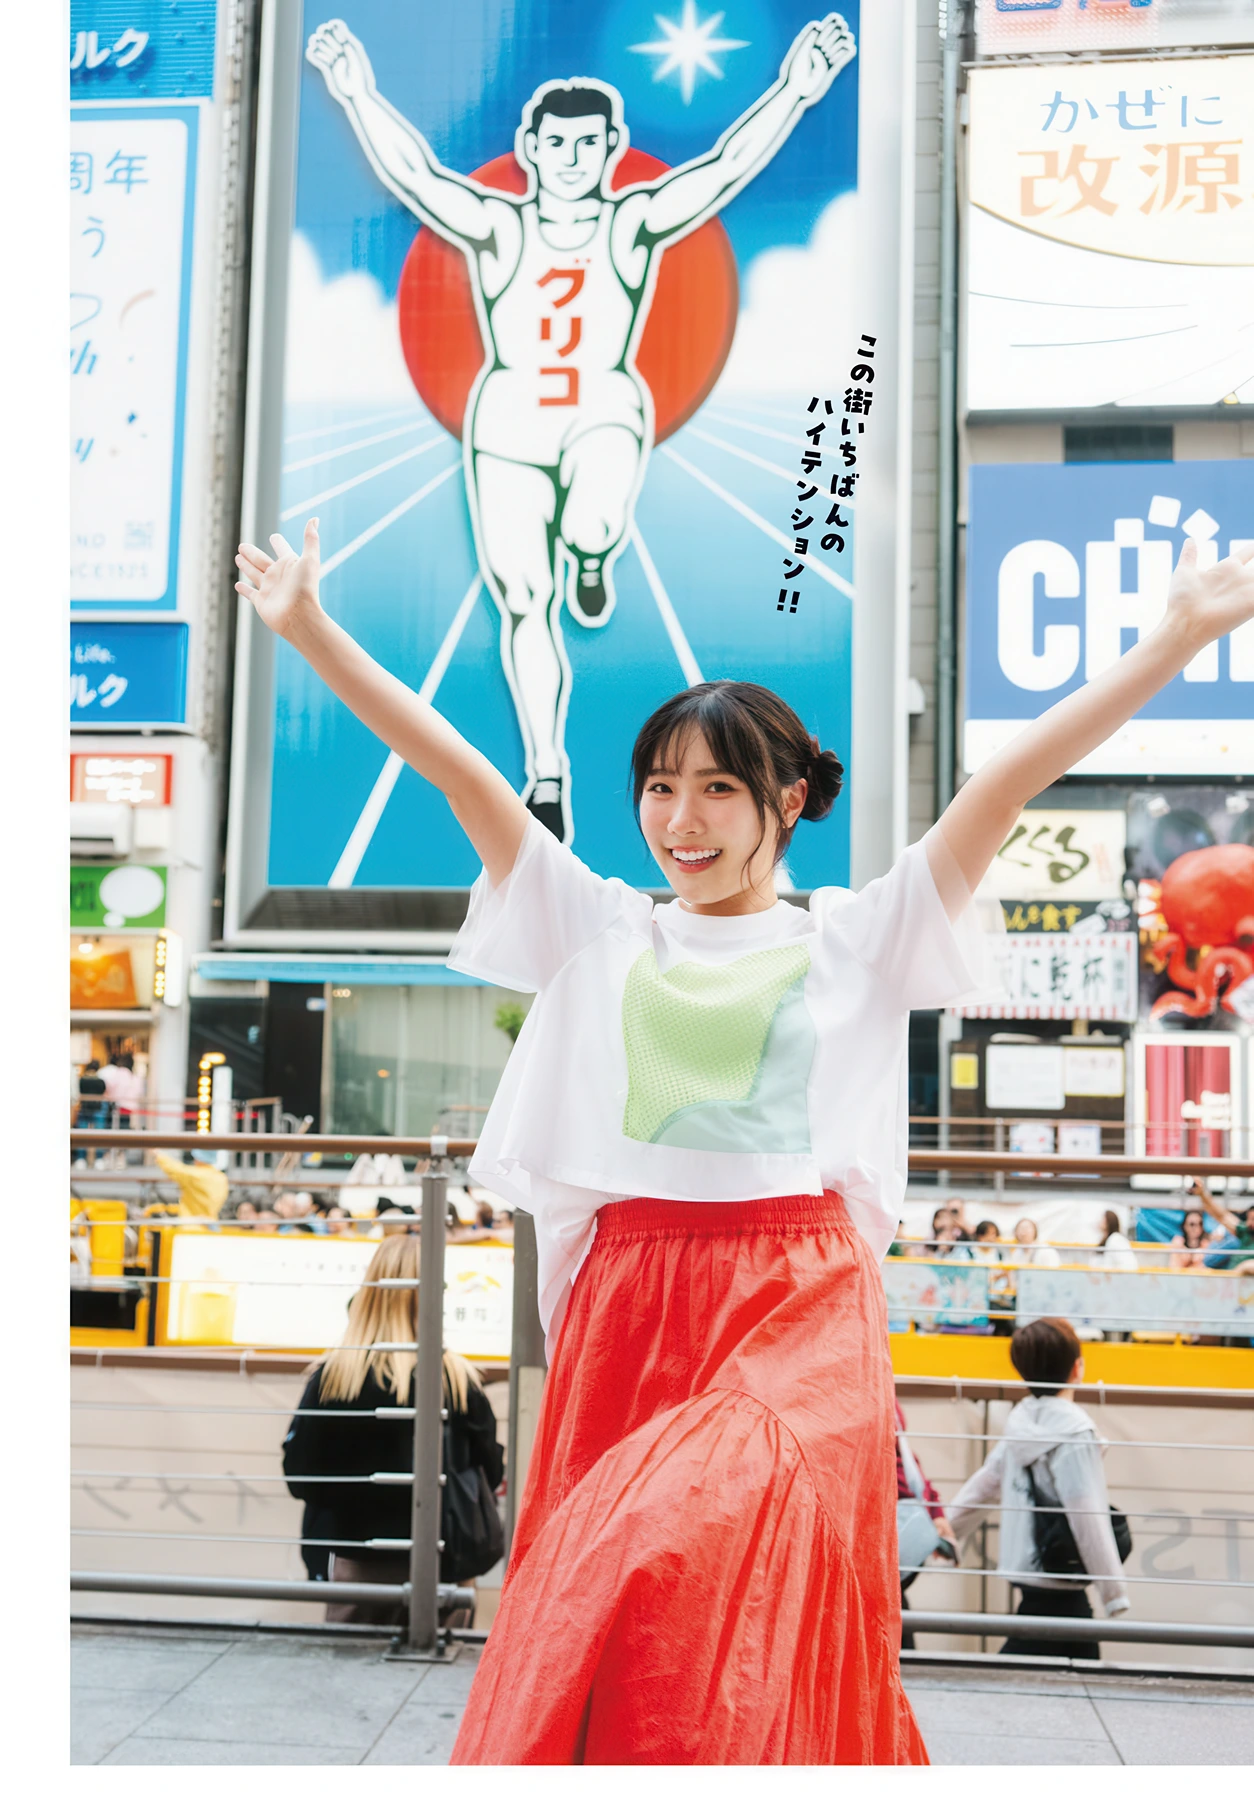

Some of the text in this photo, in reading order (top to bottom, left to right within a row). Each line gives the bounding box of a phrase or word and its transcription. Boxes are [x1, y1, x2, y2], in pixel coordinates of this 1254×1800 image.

[71, 28, 149, 69] ルク
[1040, 85, 1223, 133] かぜに
[1017, 138, 1244, 218] 改源
[81, 216, 105, 258] う
[536, 257, 592, 407] グリコ
[71, 673, 129, 708] ルク
[997, 825, 1089, 883] くくる
